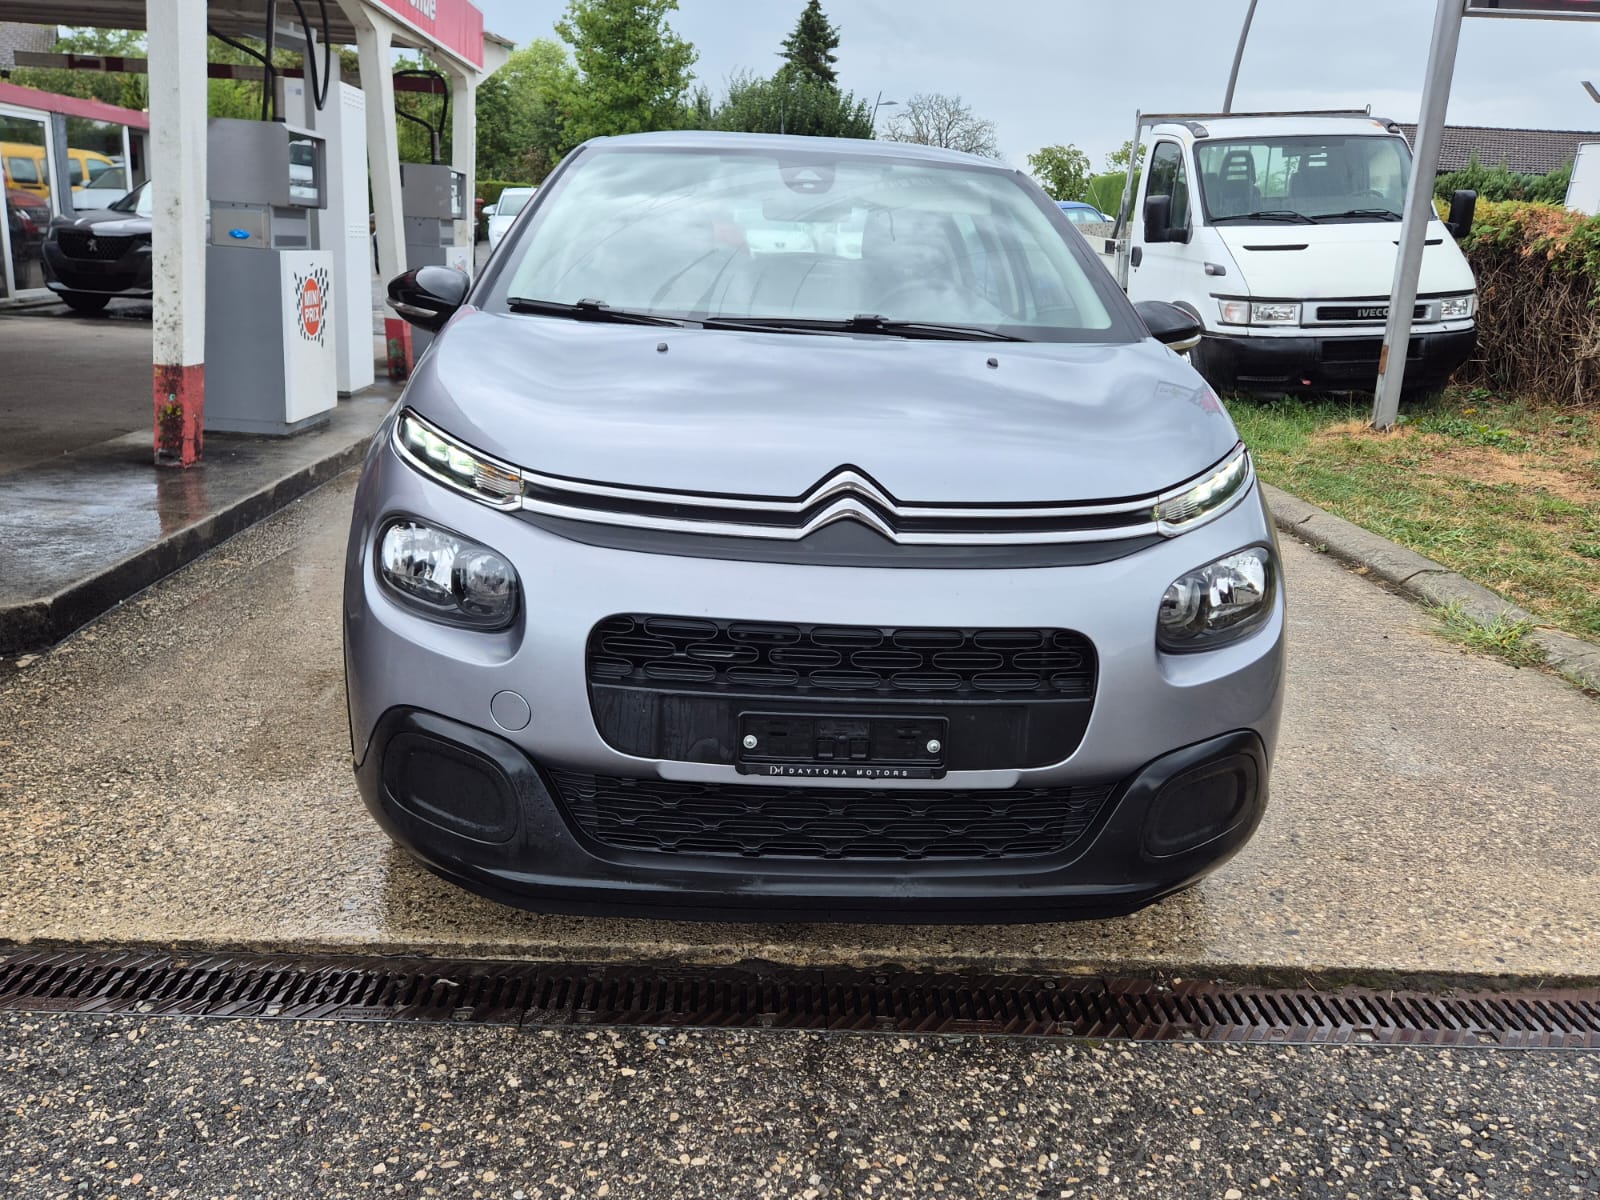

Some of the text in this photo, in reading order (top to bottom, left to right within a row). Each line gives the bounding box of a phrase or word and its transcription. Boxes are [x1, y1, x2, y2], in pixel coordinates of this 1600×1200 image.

[304, 289, 320, 306] MINI
[304, 306, 320, 323] PRIX
[788, 768, 847, 776] DAYTONA
[856, 769, 908, 777] MOTORS
